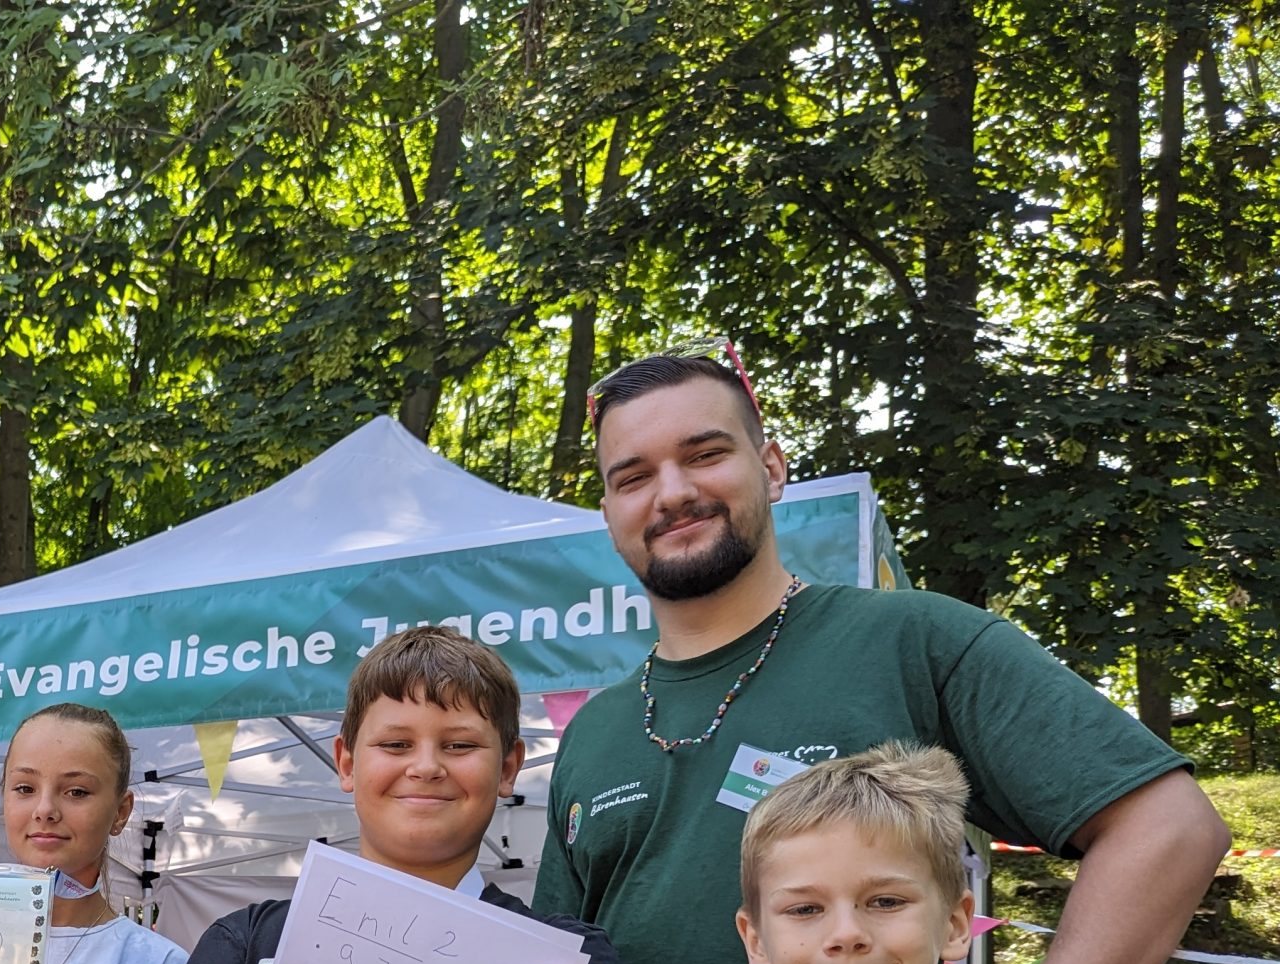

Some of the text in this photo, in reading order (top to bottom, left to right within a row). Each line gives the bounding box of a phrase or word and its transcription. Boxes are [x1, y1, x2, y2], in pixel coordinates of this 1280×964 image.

[356, 585, 652, 658] Jendh
[745, 783, 761, 795] Alex
[316, 875, 460, 958] Emil 2
